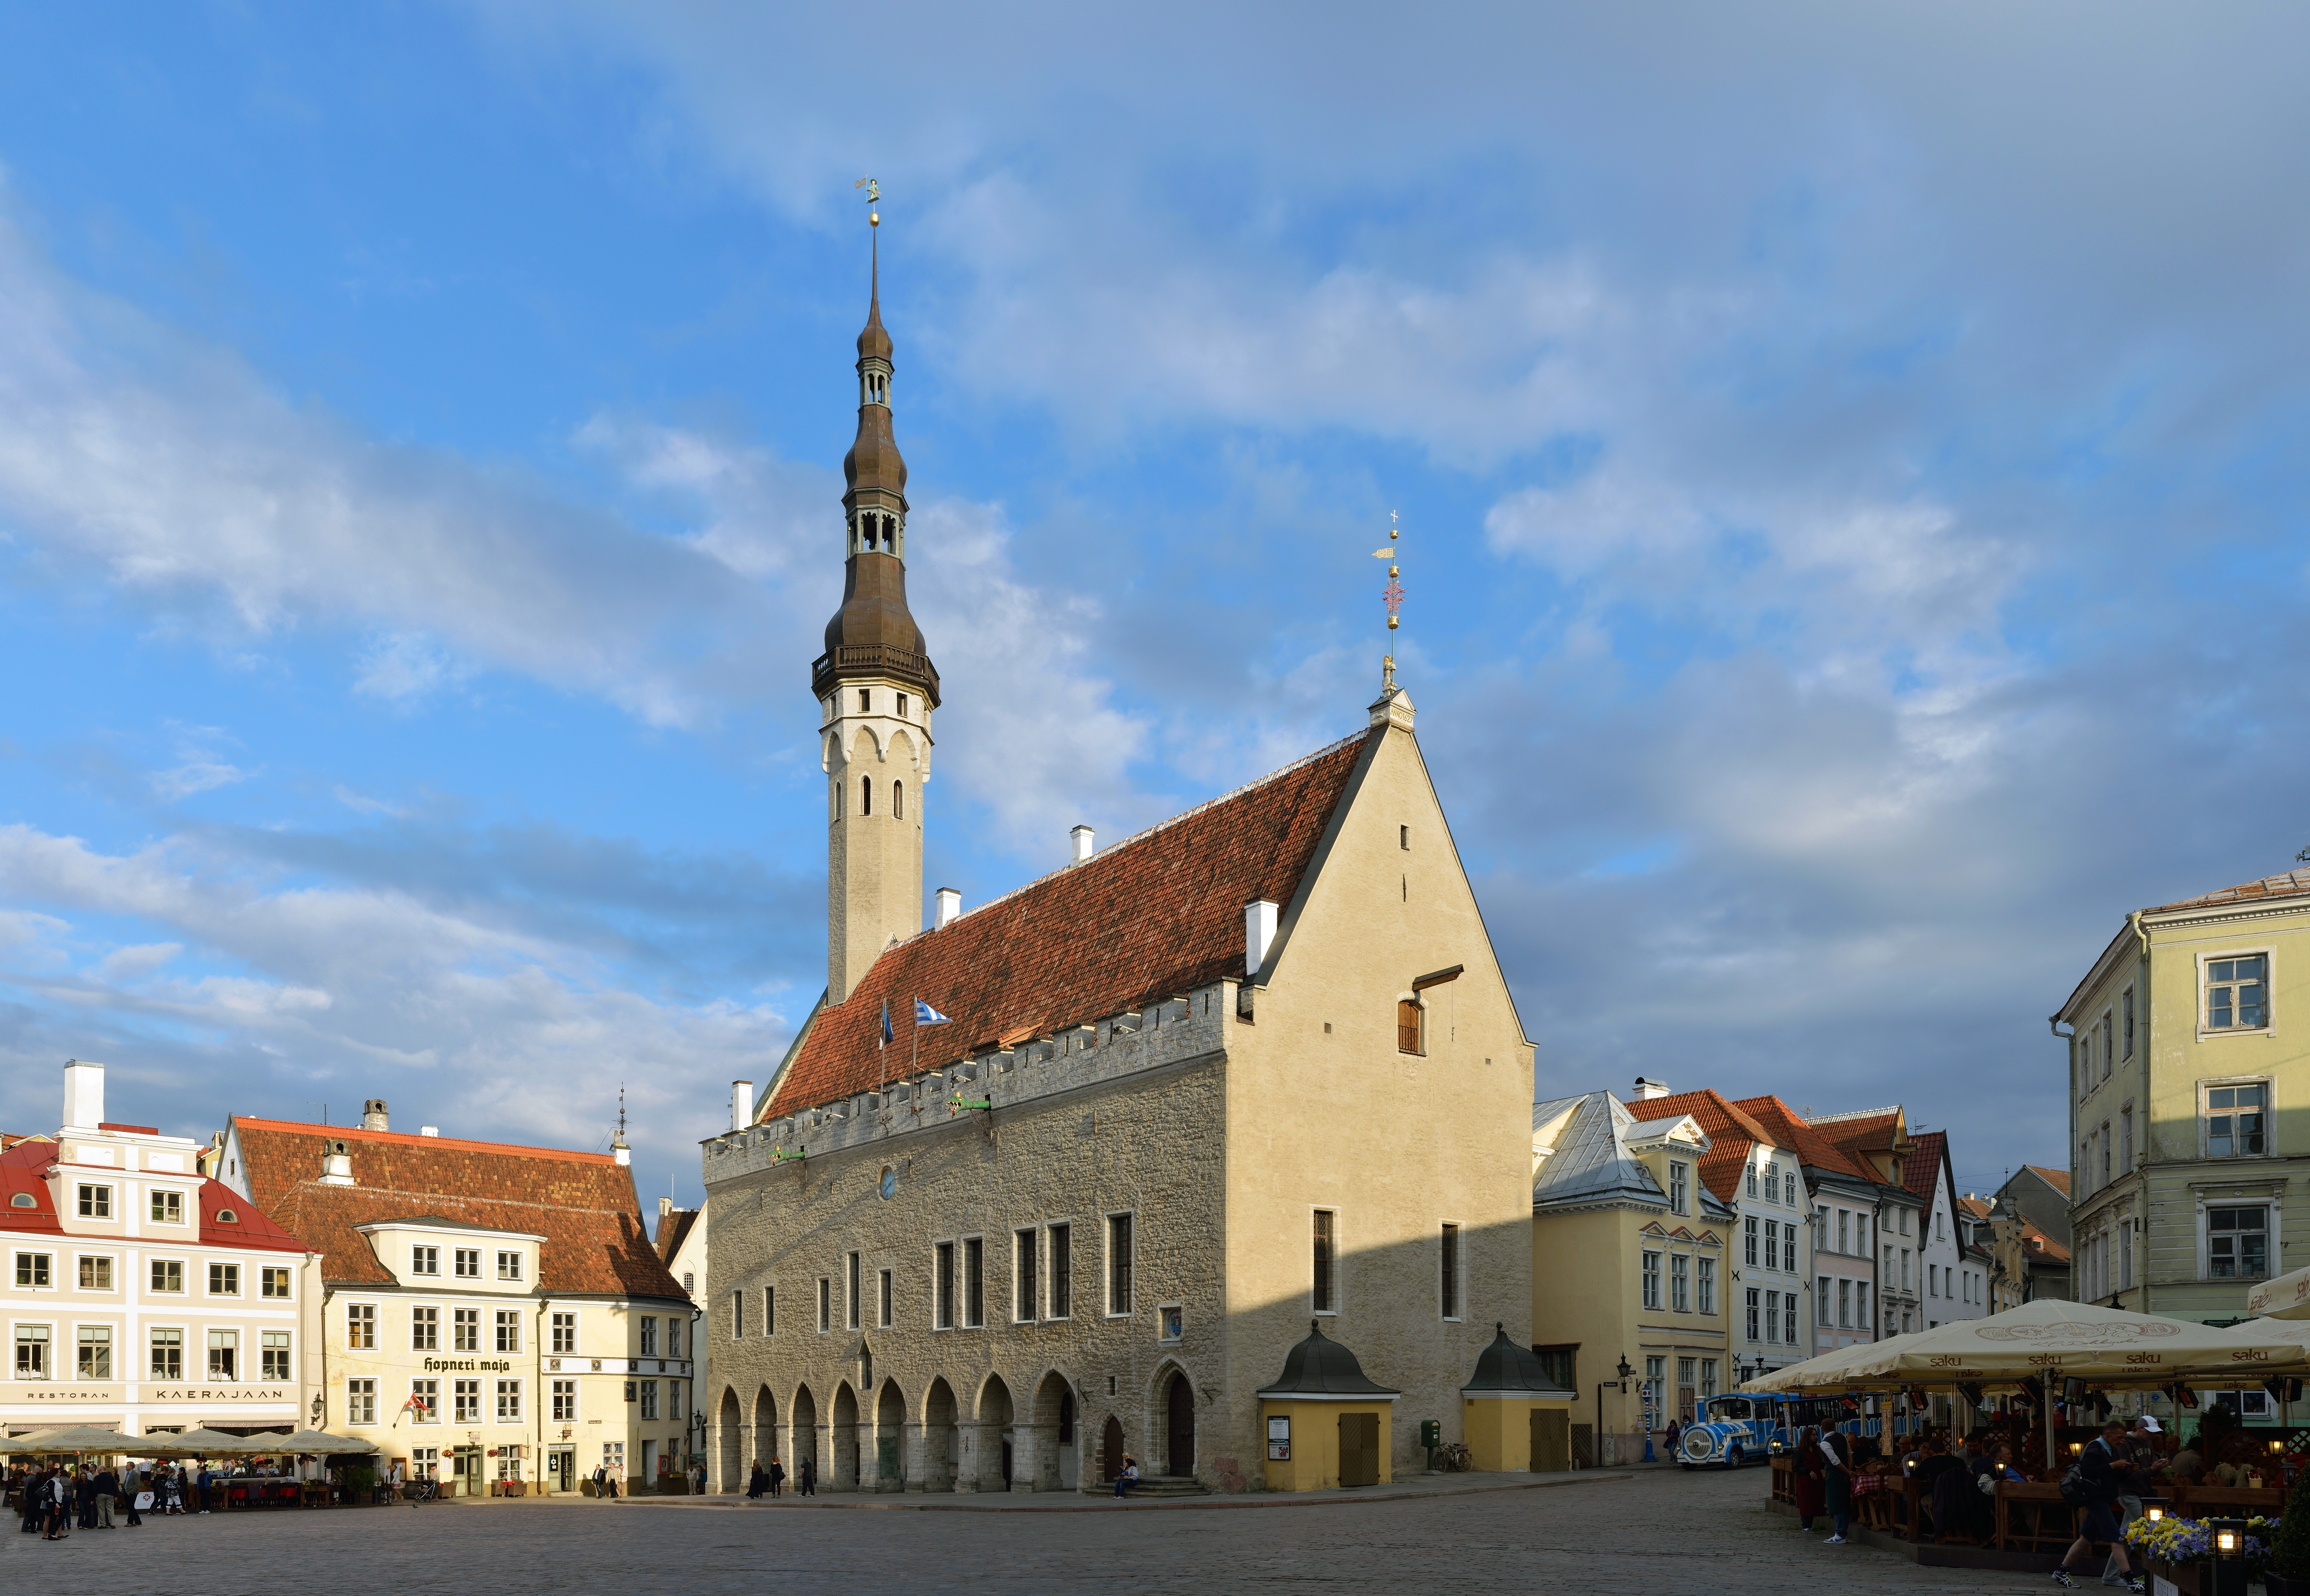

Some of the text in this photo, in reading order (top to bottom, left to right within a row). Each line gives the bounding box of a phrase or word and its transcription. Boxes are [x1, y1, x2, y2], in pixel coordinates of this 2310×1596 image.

[2028, 1353, 2062, 1365] saku
[2126, 1352, 2161, 1364] saku
[2232, 1348, 2268, 1361] saku
[480, 1359, 510, 1373] maja
[1930, 1355, 1962, 1367] saku
